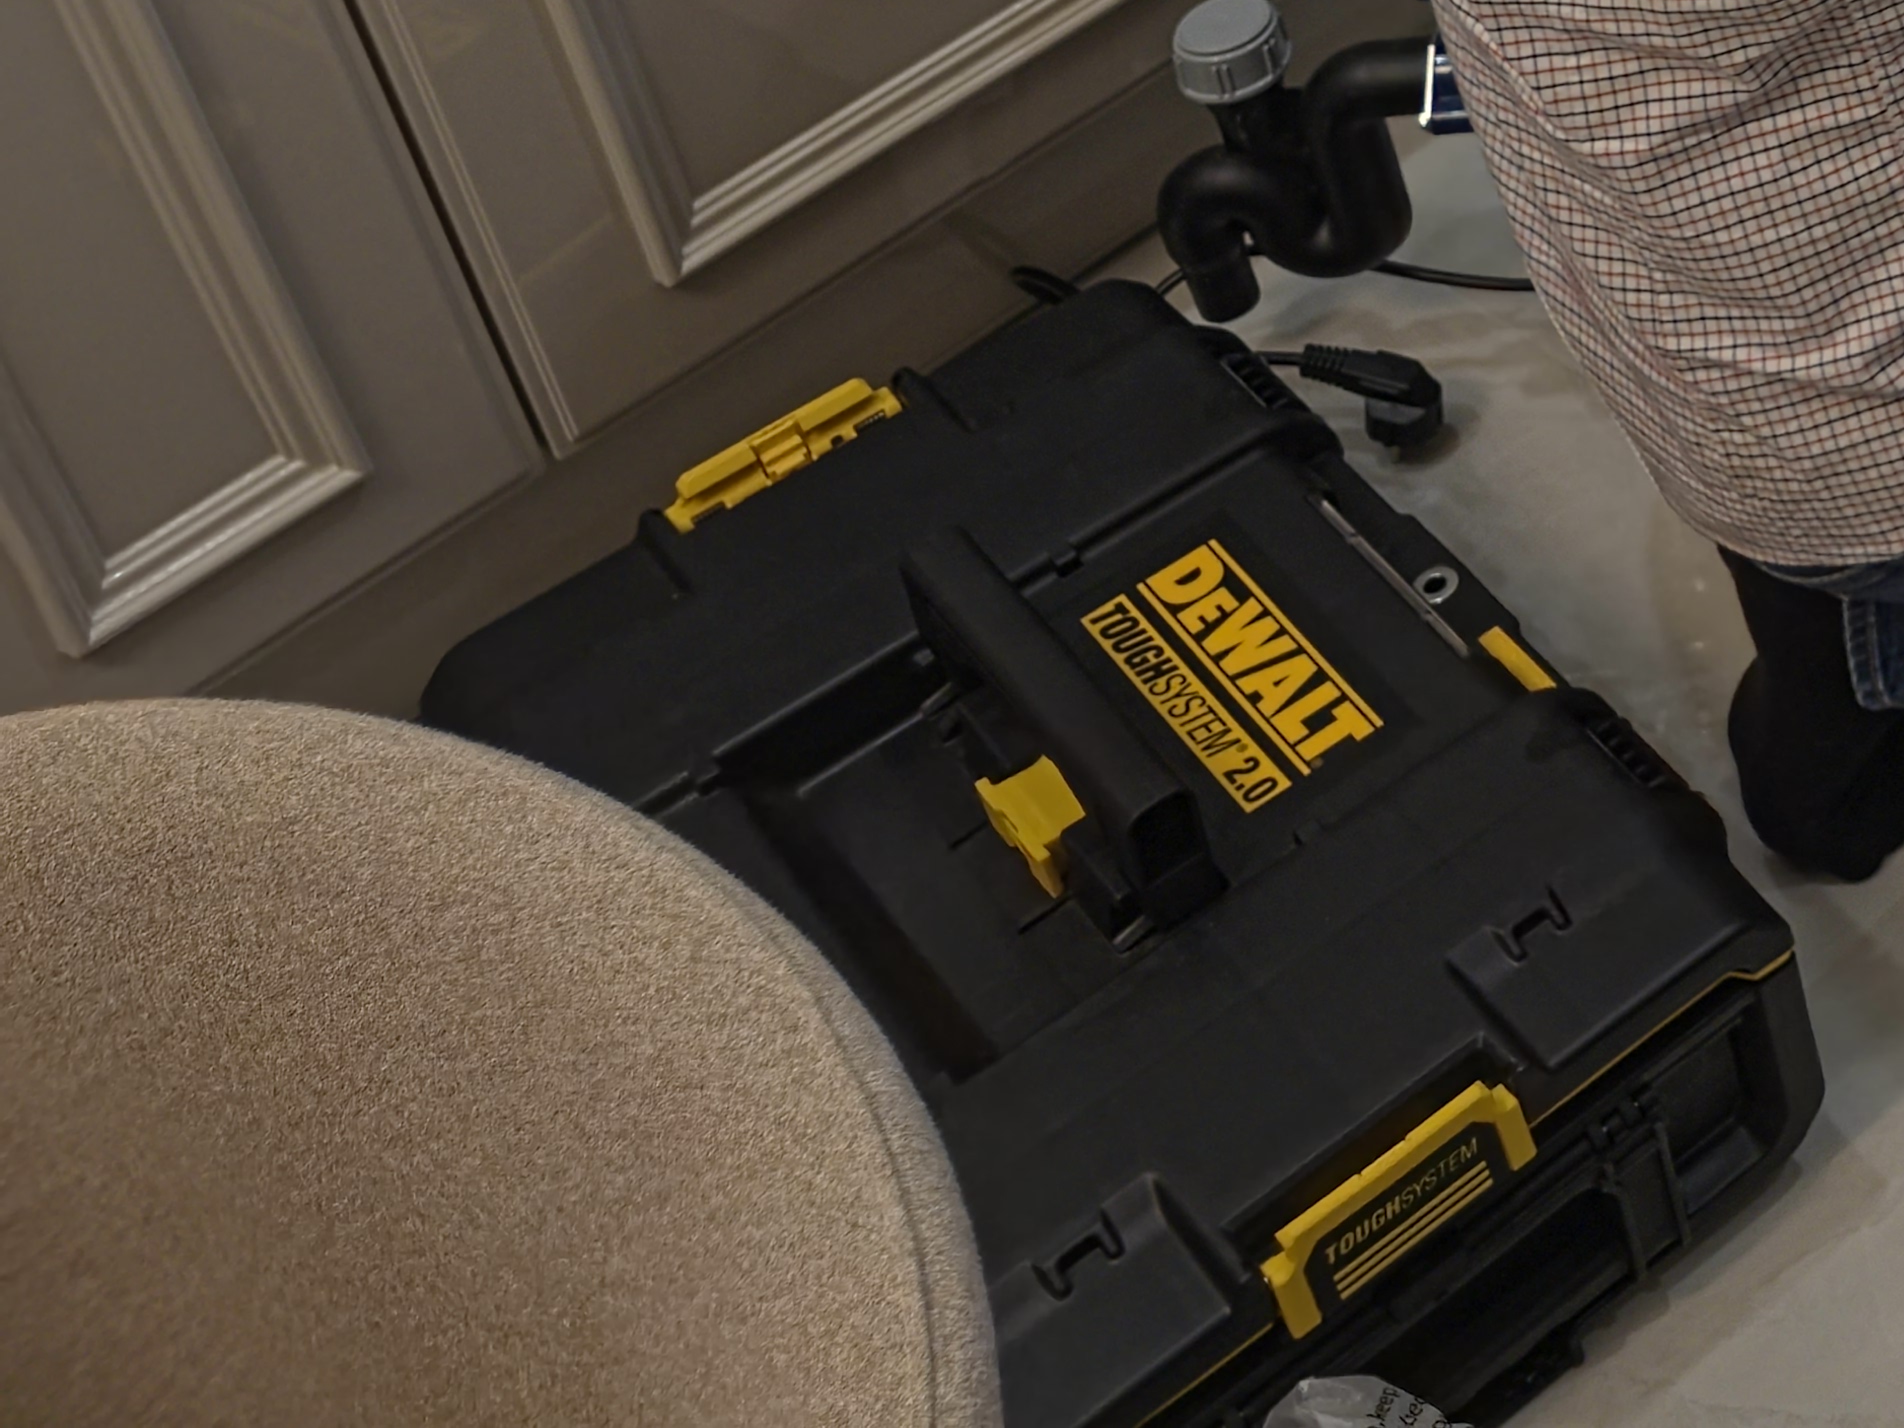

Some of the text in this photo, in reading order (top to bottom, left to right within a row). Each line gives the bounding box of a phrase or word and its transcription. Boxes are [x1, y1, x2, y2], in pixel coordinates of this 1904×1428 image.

[1089, 602, 1279, 804] TOUGHSYSTEM 2.0
[1144, 543, 1376, 763] DEWALT
[1324, 1137, 1478, 1265] TOUGHSYSTEM
